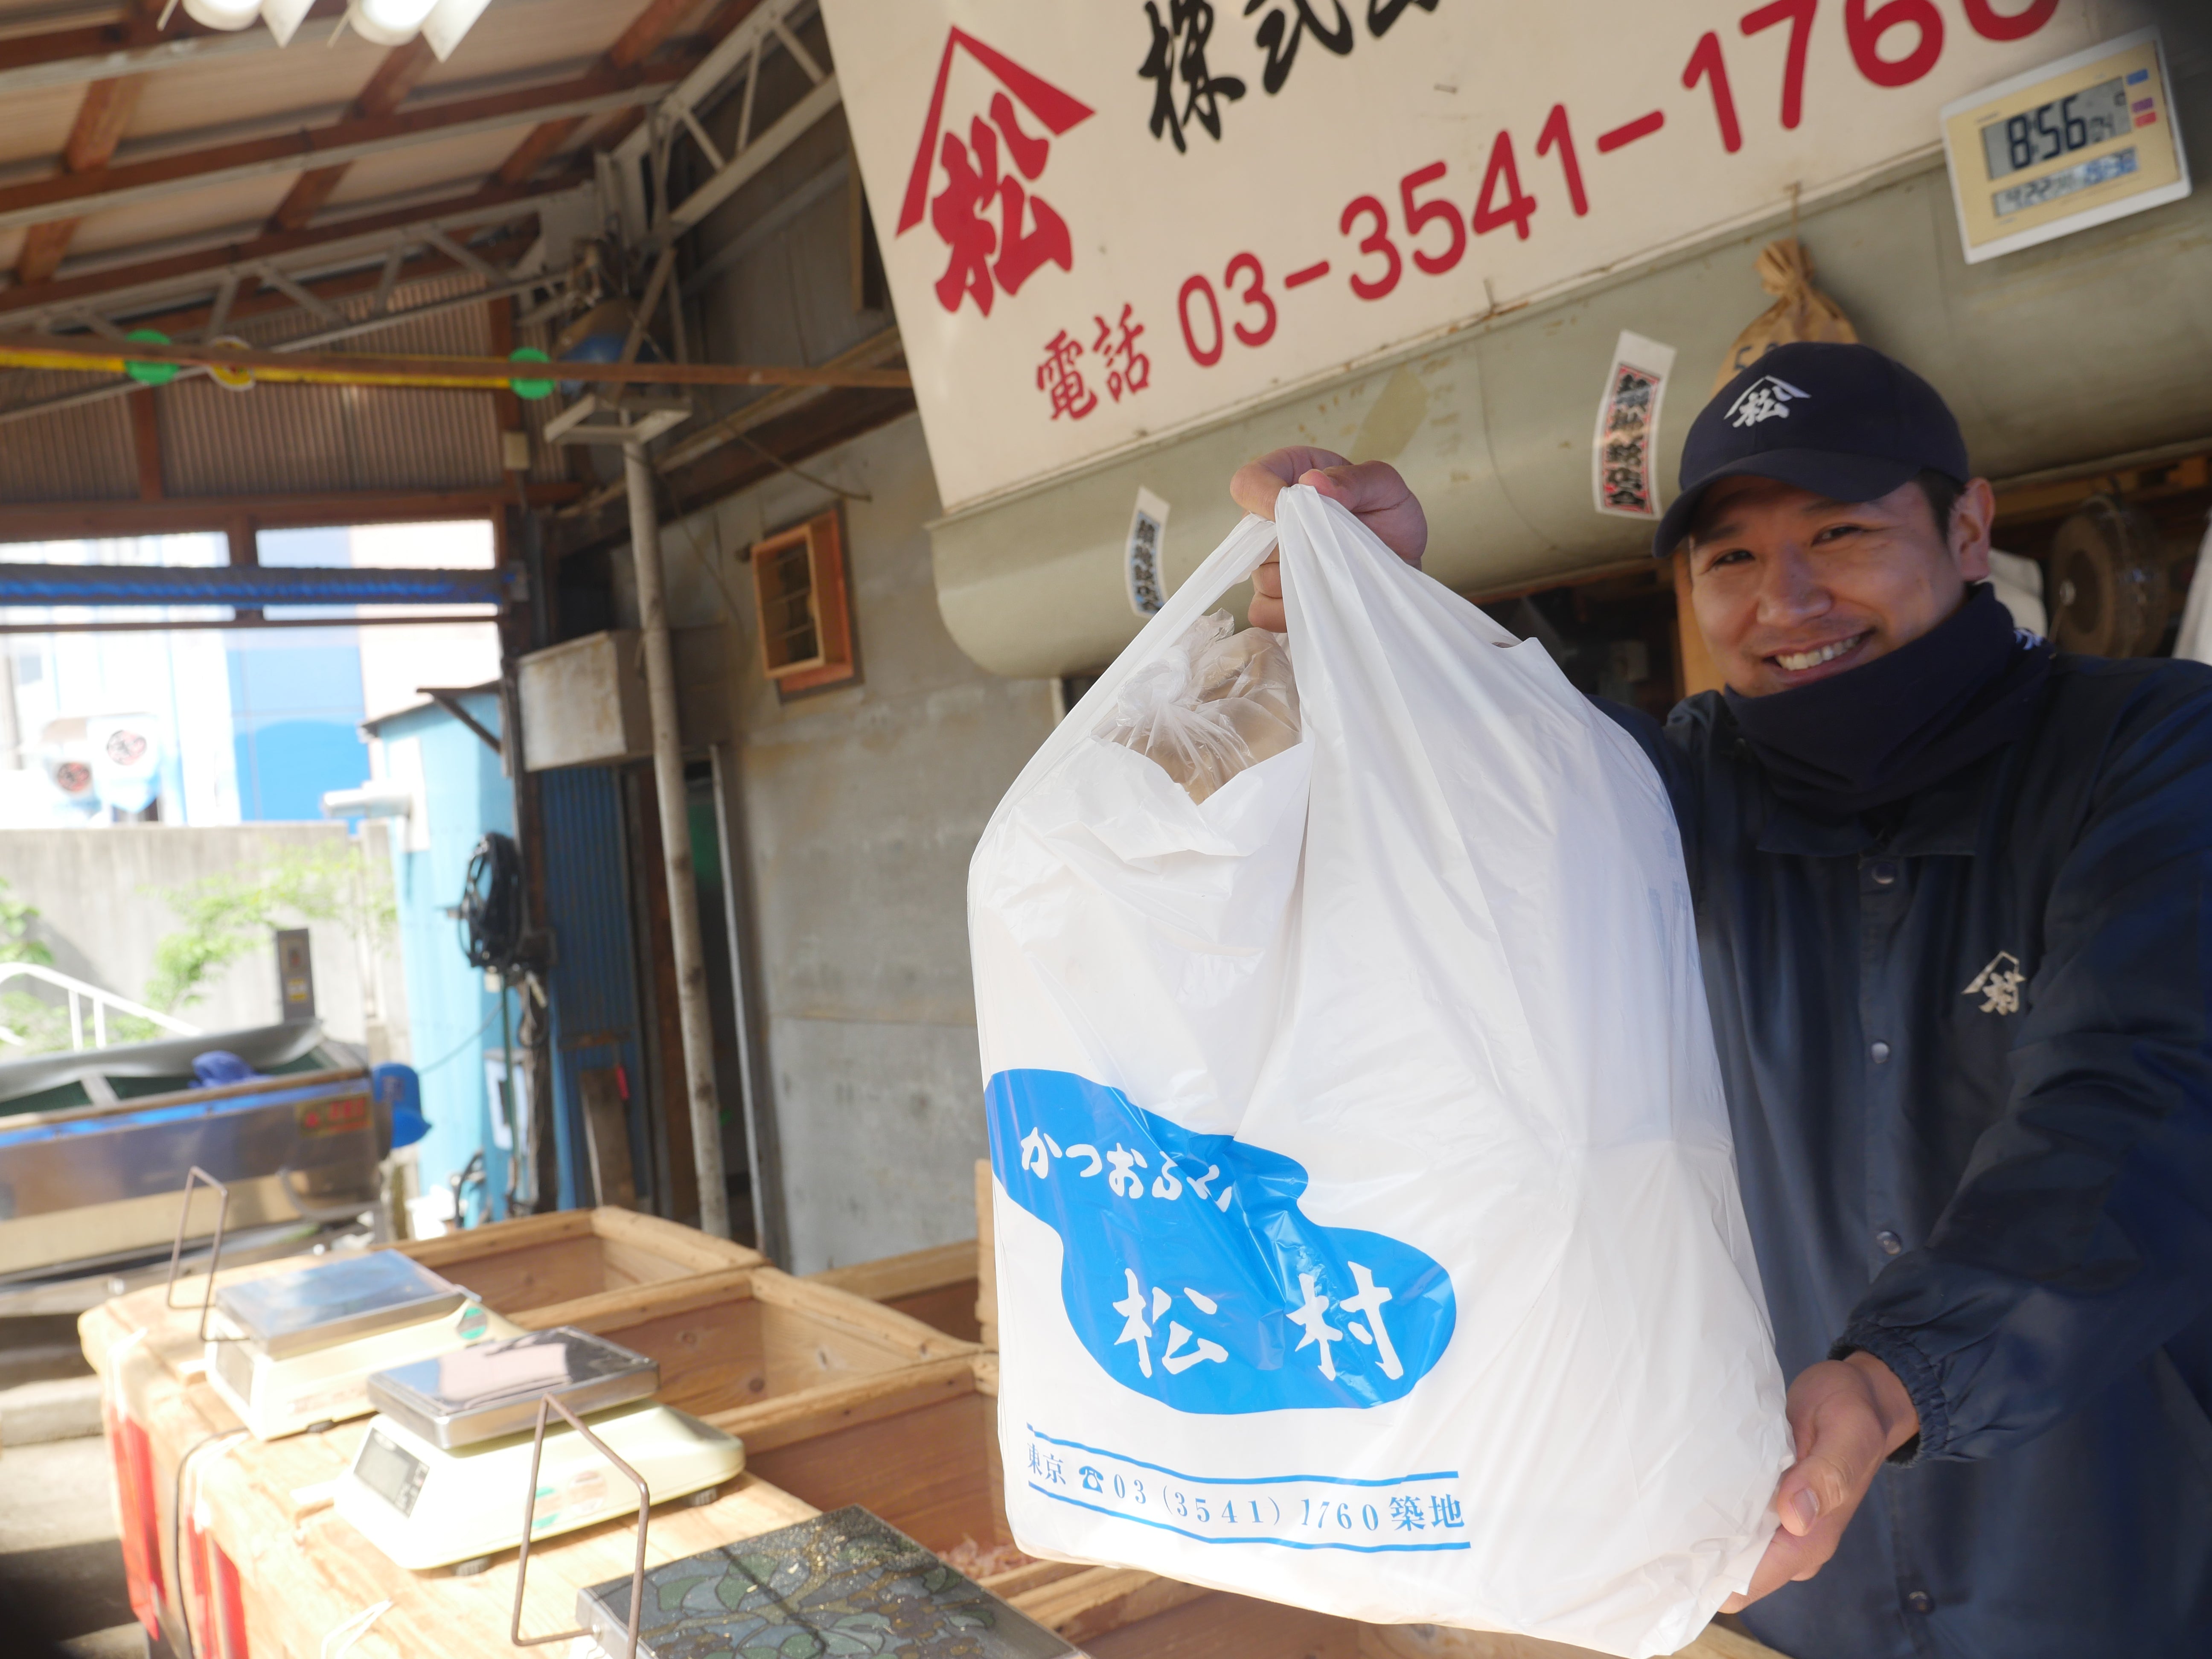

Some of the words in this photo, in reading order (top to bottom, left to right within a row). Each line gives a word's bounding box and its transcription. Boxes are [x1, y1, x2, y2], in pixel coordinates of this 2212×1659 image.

[2007, 94, 2088, 170] 8:56
[1036, 303, 1151, 420] 電話
[1113, 1261, 1404, 1381] 松村
[1027, 1443, 1066, 1485] 東京
[1114, 1474, 1146, 1504] 03
[1301, 1499, 1379, 1531] 1760
[1388, 1494, 1464, 1531] 築地
